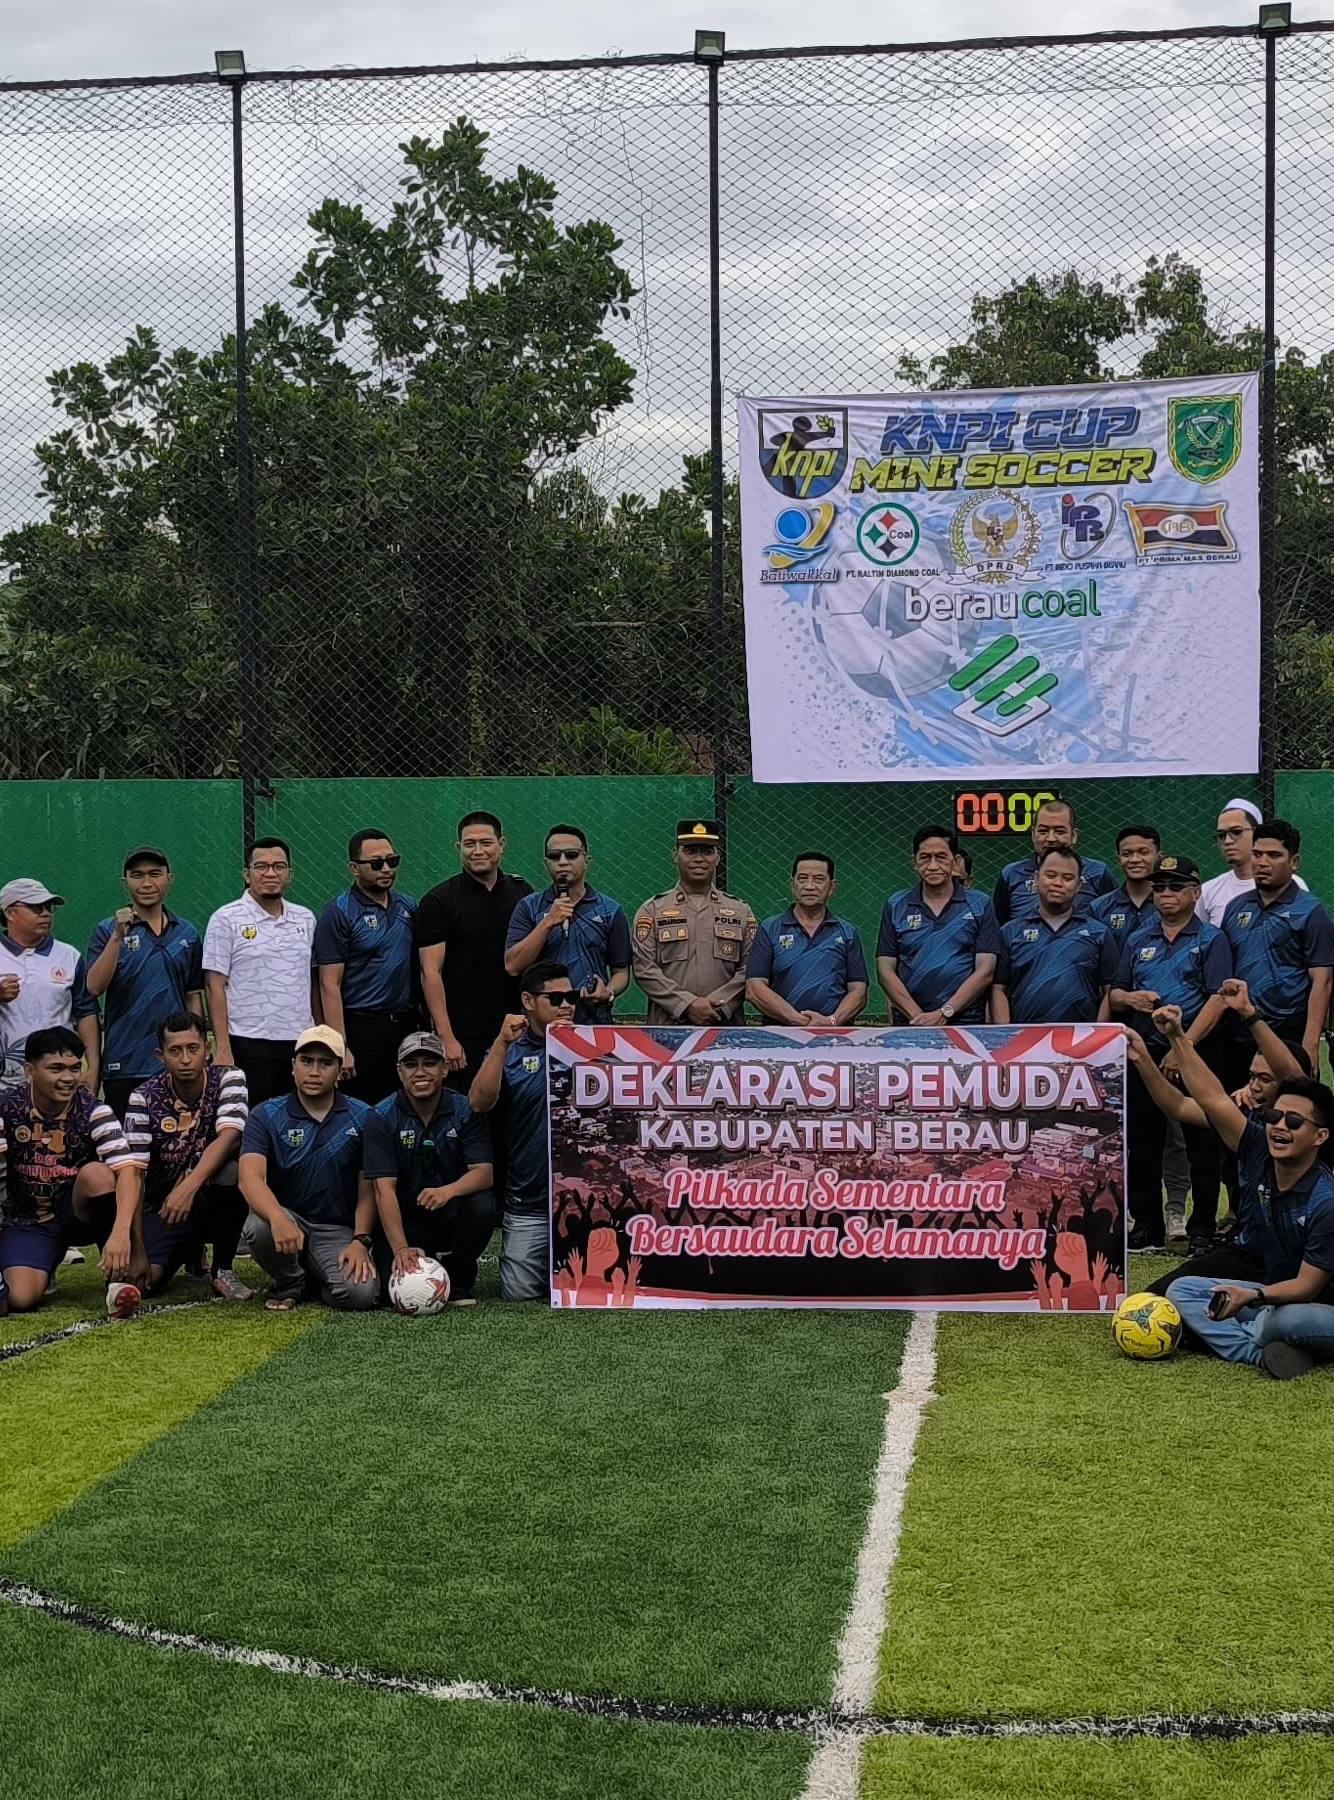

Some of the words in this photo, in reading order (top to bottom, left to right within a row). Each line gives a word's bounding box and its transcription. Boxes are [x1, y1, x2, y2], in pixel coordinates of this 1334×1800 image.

[880, 410, 1018, 456] KNPI
[1023, 407, 1141, 450] CUP
[770, 432, 839, 498] knpi
[849, 455, 962, 493] MINI
[962, 448, 1157, 490] SOCCER
[889, 529, 913, 540] Coal
[886, 568, 919, 577] DIAMOND
[921, 568, 940, 577] COAL
[976, 561, 1014, 573] DPRD
[715, 916, 741, 925] POLRI
[572, 1063, 854, 1109] DEKLARASI
[877, 1062, 1102, 1109] PEMUDA
[639, 1118, 874, 1151] KABUPATEN
[892, 1118, 1029, 1152] BERAU
[663, 1168, 808, 1211] Pilkada
[809, 1168, 1007, 1213] Sementara
[626, 1215, 837, 1258] Bersaudara
[839, 1215, 1047, 1270] Selamanya
